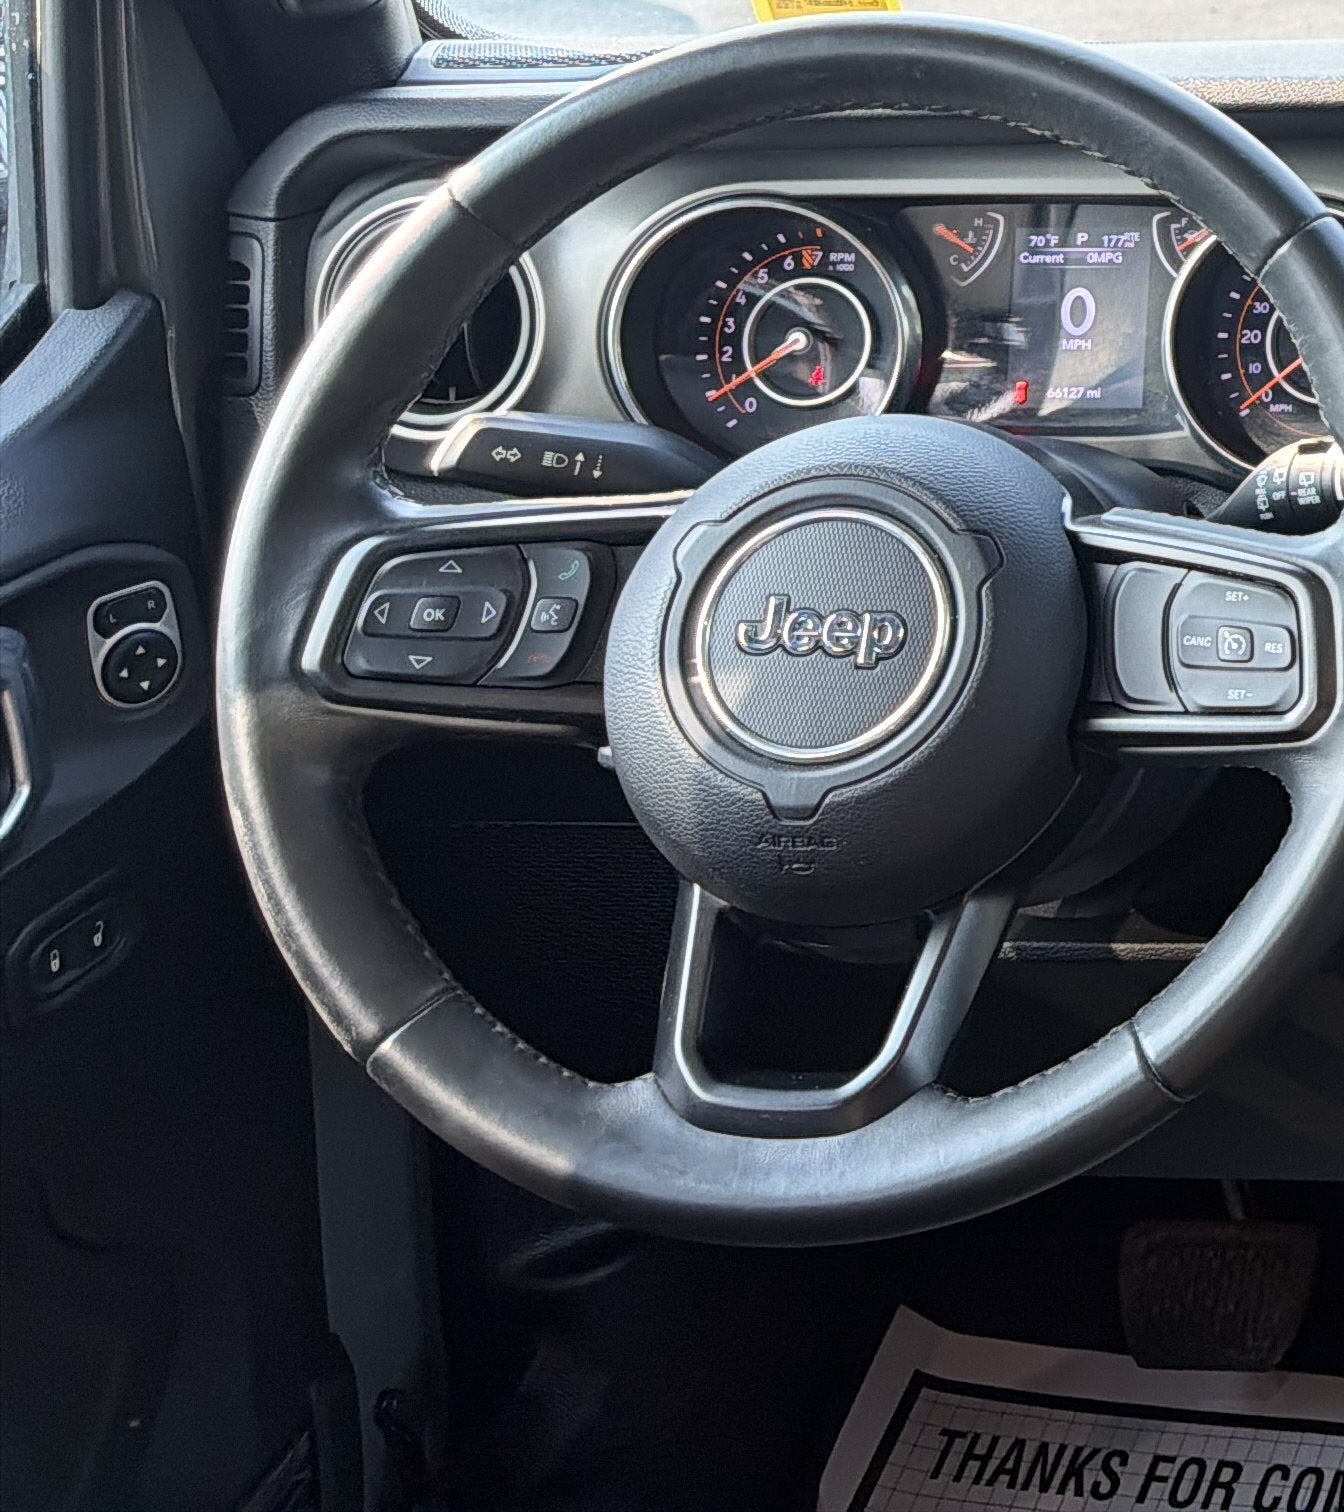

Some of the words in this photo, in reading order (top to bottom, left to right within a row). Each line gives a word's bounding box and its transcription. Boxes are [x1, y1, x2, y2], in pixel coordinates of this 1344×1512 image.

[1076, 232, 1089, 246] P
[1102, 235, 1125, 248] 177
[783, 256, 795, 270] 6
[811, 251, 823, 266] 7
[829, 252, 856, 262] RPM
[1019, 252, 1065, 264] Current
[1086, 252, 1123, 264] 0MPG
[757, 269, 769, 284] 5
[735, 289, 747, 305] 4
[1060, 287, 1096, 336] 0
[1252, 302, 1270, 314] 30
[724, 318, 736, 333] 3
[1240, 330, 1262, 344] 20
[1061, 338, 1092, 351] MPH
[721, 347, 733, 362] 2
[1248, 362, 1262, 374] 10
[1046, 386, 1084, 399] 66127
[1086, 387, 1102, 399] mi
[1261, 389, 1273, 402] 0
[745, 397, 757, 413] 0
[1269, 403, 1293, 414] MPH
[1272, 490, 1287, 501] OFF
[147, 600, 157, 610] R
[109, 613, 118, 624] L
[422, 608, 447, 622] OK
[735, 593, 909, 670] Jeep
[1183, 635, 1212, 648] CANC
[1264, 642, 1284, 654] RES
[926, 1428, 1129, 1502] THANKS
[1142, 1455, 1239, 1512] FOR
